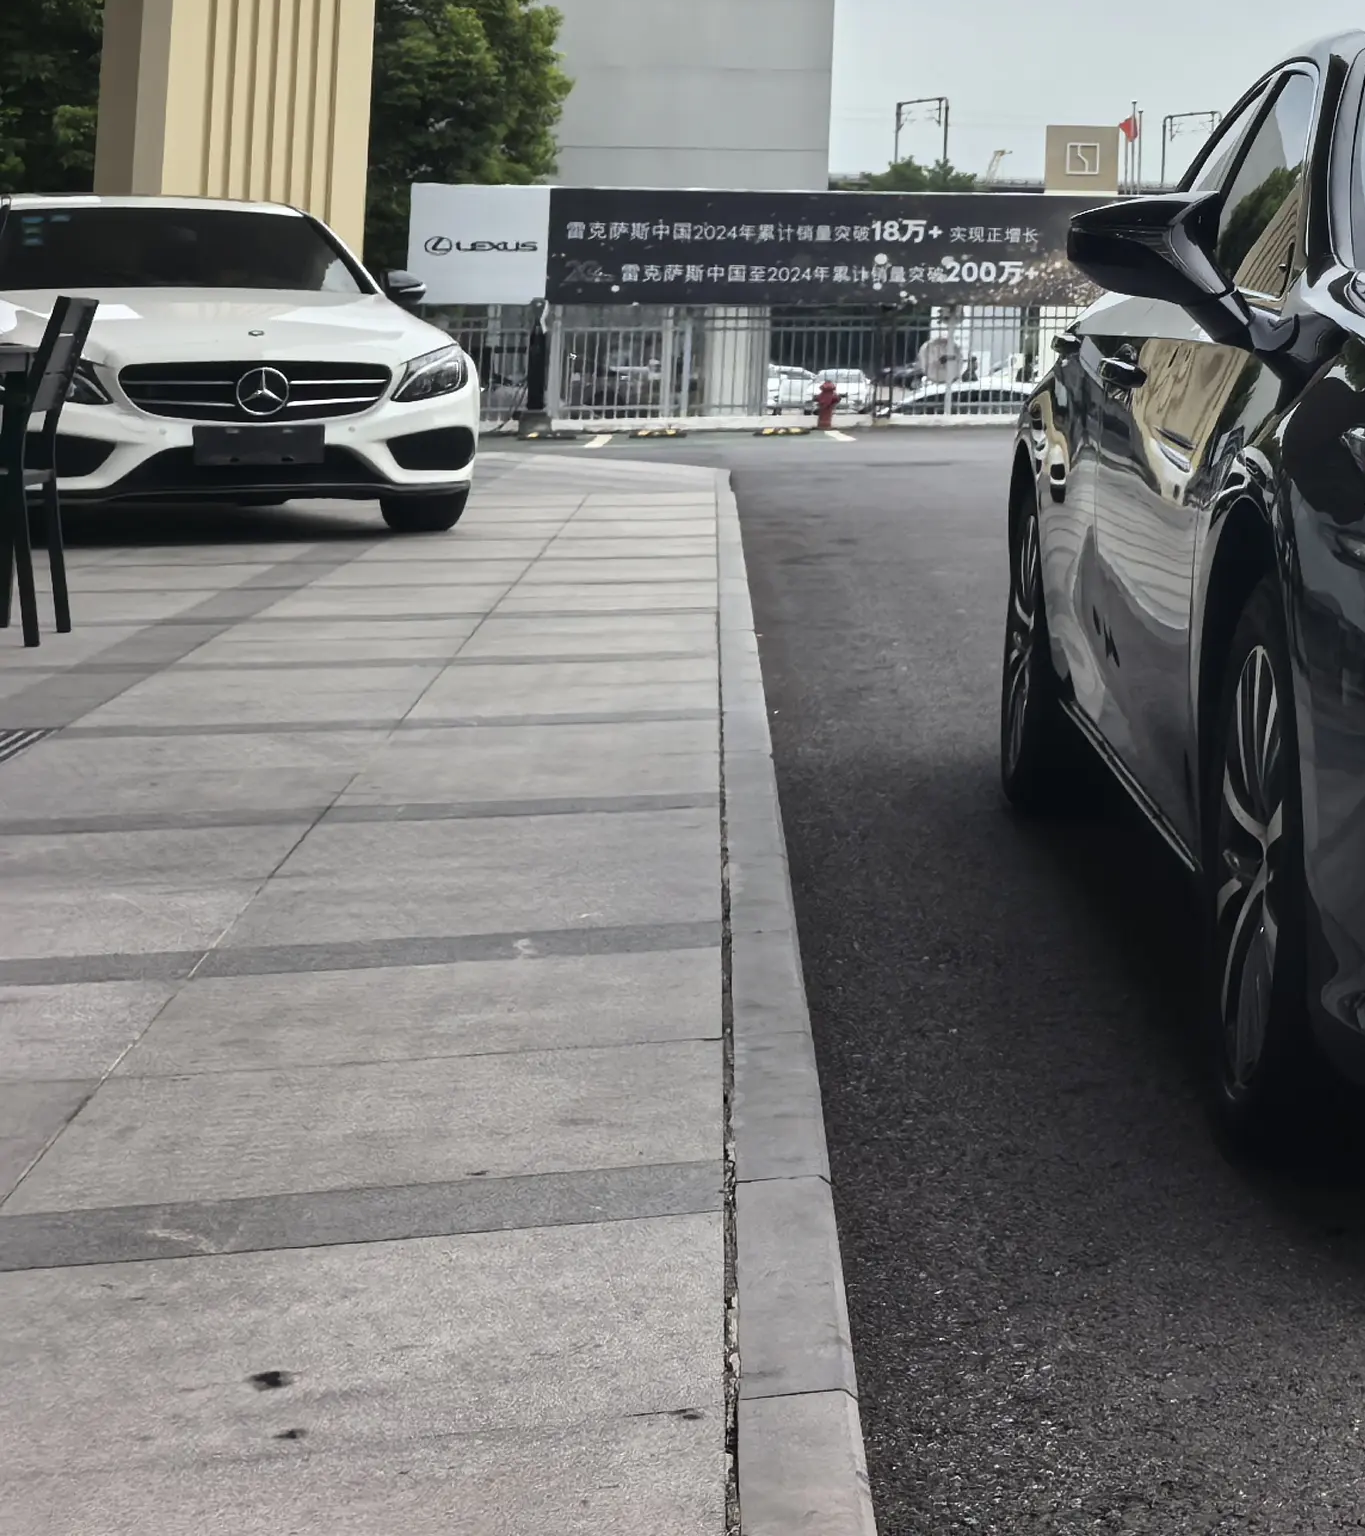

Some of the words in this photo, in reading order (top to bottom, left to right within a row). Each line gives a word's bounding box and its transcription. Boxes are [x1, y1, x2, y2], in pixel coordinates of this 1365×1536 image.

[949, 226, 1039, 244] 实现正增长
[456, 240, 538, 252] LEXUS
